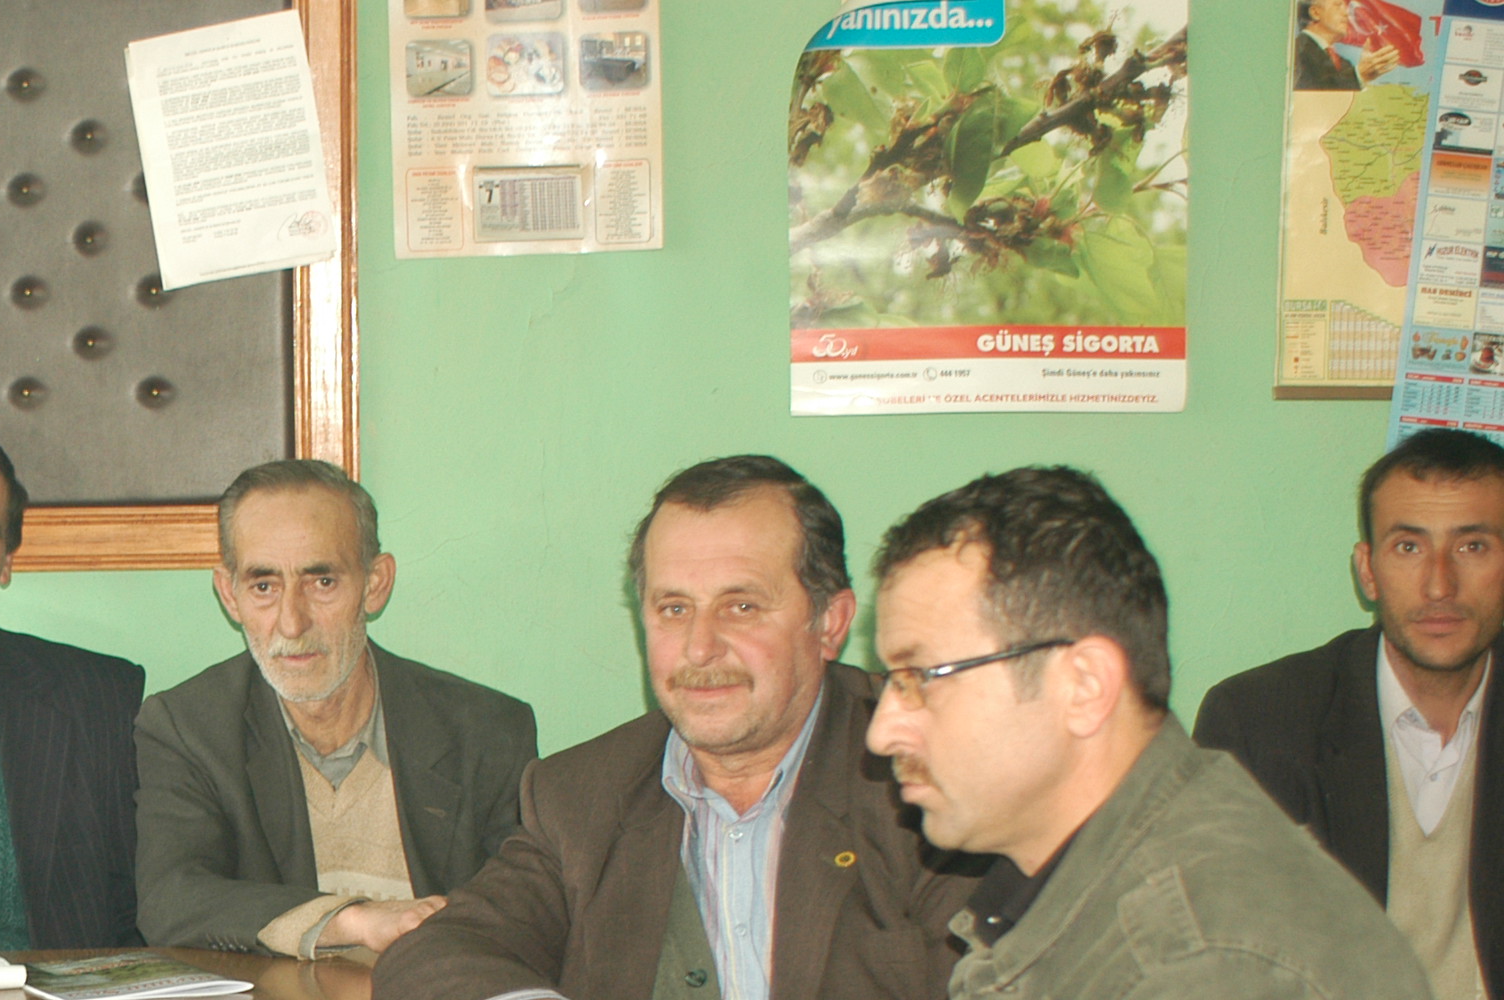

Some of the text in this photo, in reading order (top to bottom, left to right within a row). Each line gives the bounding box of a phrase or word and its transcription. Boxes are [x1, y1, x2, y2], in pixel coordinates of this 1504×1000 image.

[977, 330, 1160, 356] GÜNEŞ SİGORTA
[1041, 368, 1064, 378] Şimdi
[1099, 368, 1118, 378] daha
[944, 391, 972, 404] ÖZEL
